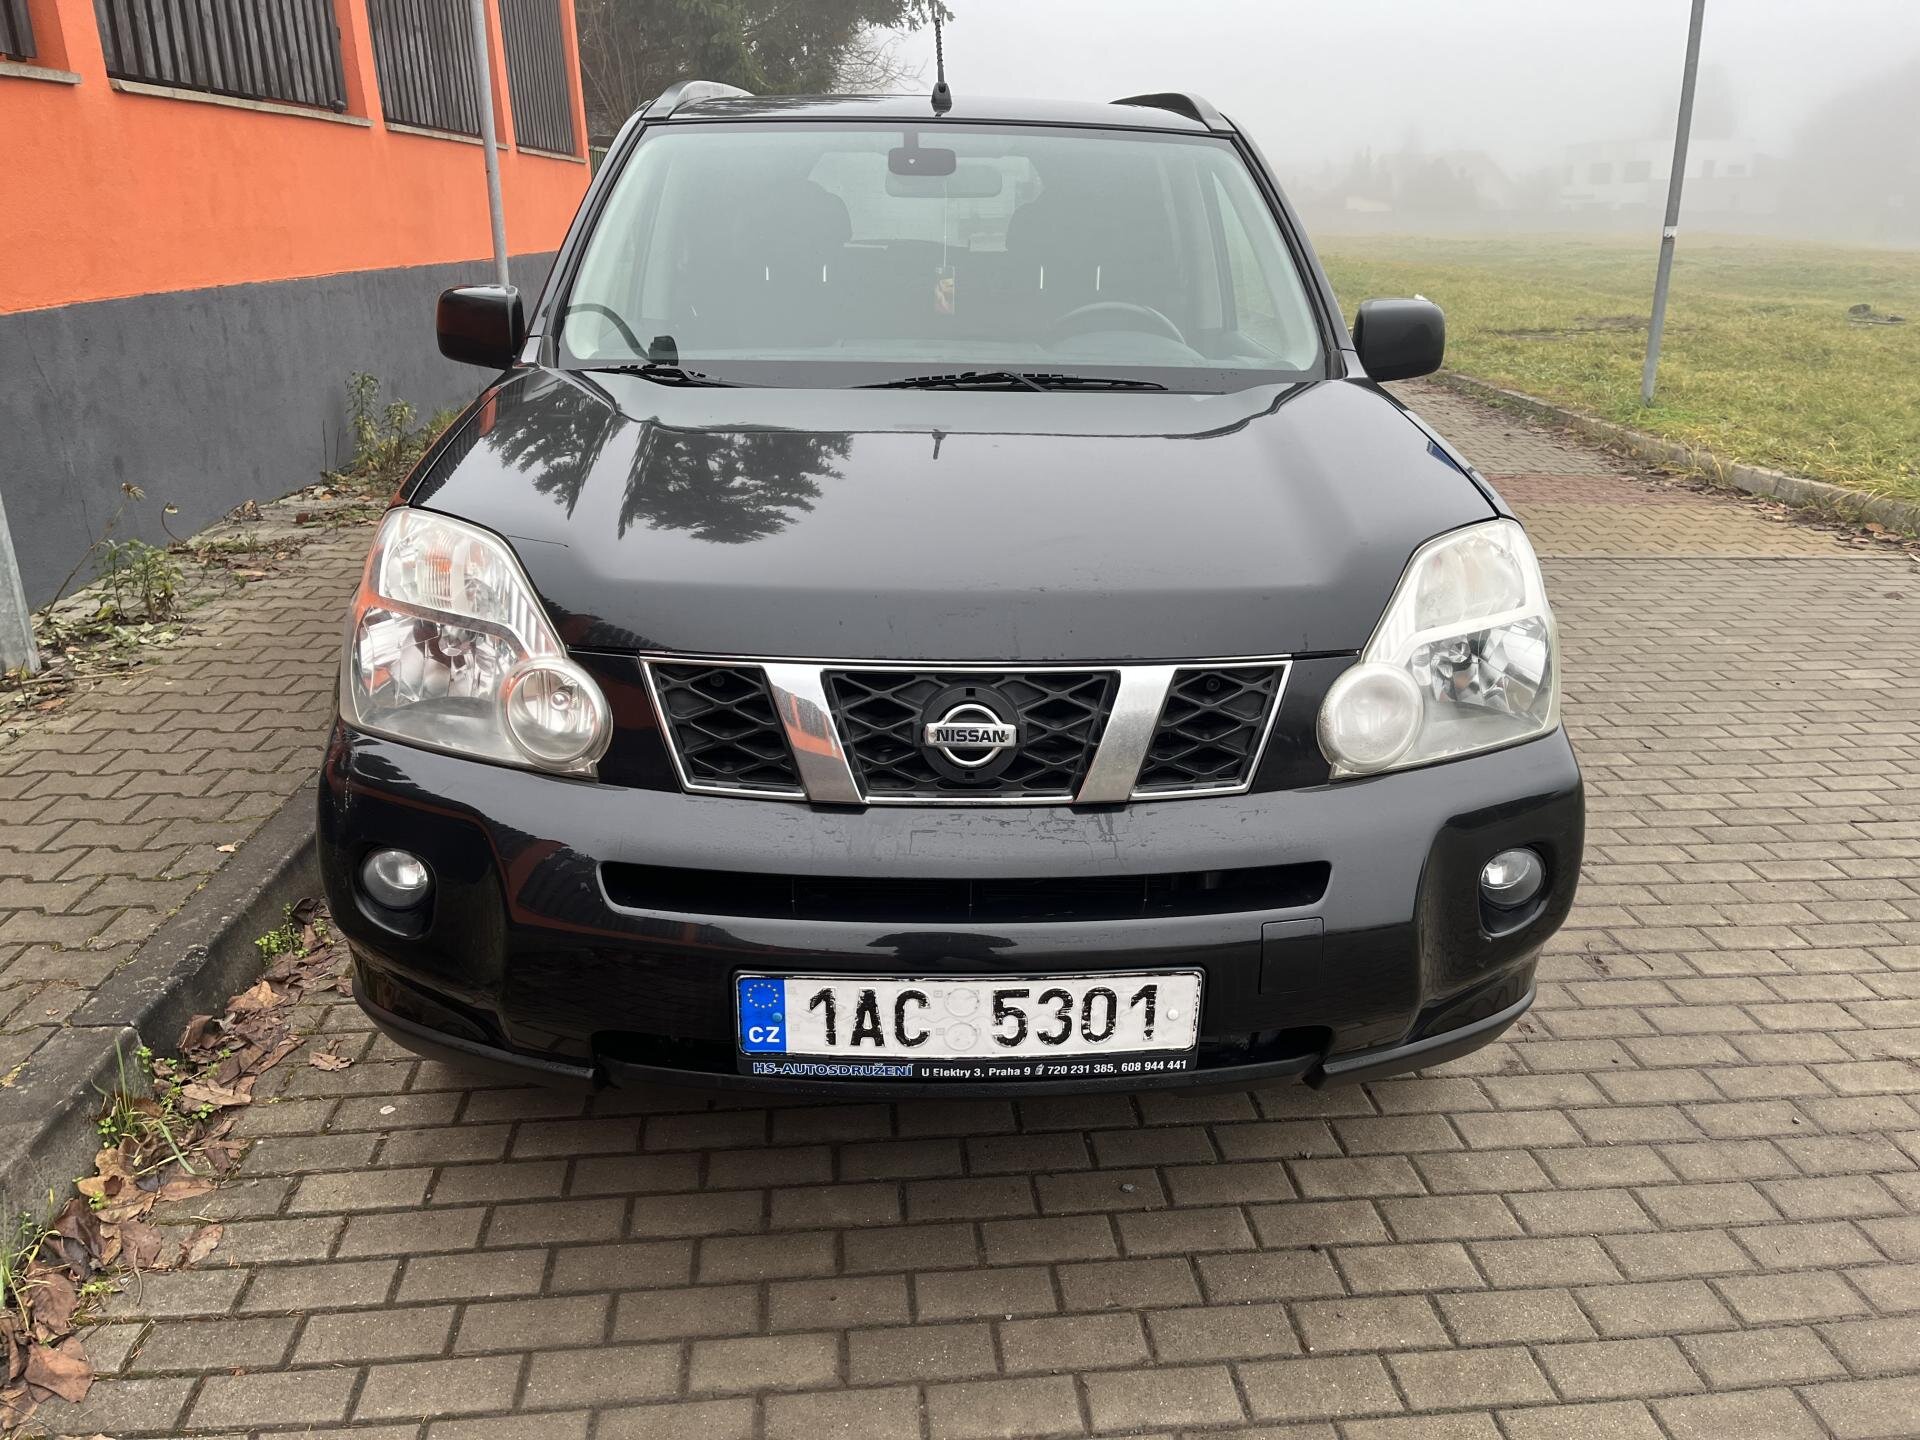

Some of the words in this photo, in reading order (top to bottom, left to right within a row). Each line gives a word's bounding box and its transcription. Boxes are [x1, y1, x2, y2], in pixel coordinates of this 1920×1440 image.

[936, 729, 1006, 743] NISSAN
[810, 986, 931, 1047] 1AC
[992, 984, 1158, 1048] 5301
[748, 1026, 780, 1043] CZ
[752, 1062, 914, 1077] HS-AUTOSDRUŽENÍ
[921, 1068, 930, 1077] U
[933, 1068, 971, 1079] Elektry
[973, 1068, 985, 1078] 3,
[988, 1067, 1020, 1077] Praha
[1024, 1066, 1031, 1076] 9
[1047, 1065, 1068, 1075] 720
[1070, 1064, 1090, 1074] 231
[1093, 1063, 1118, 1074] 385,
[1121, 1062, 1142, 1072] 608
[1144, 1060, 1164, 1071] 944
[1167, 1059, 1187, 1070] 441
